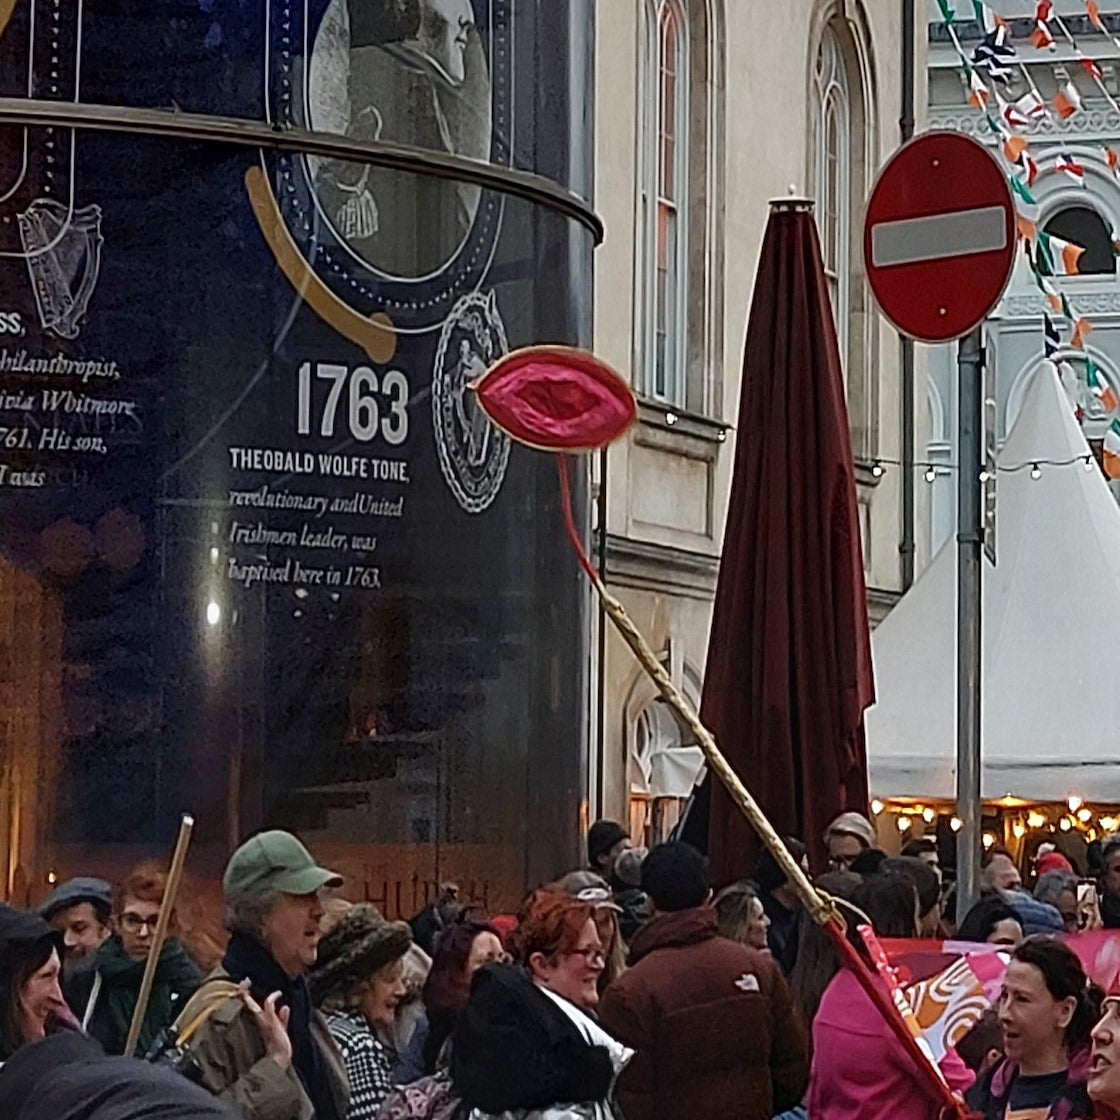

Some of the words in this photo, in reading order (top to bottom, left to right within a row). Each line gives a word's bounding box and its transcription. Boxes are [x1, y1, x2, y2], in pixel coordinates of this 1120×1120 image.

[298, 362, 408, 444] 1763
[38, 427, 72, 450] His
[72, 436, 107, 454] son,
[229, 447, 314, 473] THEOBALD
[318, 453, 368, 478] WOLFE
[371, 459, 410, 484] TONE,
[229, 485, 328, 518] revolutionary
[330, 492, 359, 513] and
[359, 494, 404, 516] United
[230, 521, 297, 546] Irishmen
[300, 523, 348, 552] leader,
[351, 536, 376, 551] was
[228, 557, 291, 588] baptised
[293, 560, 324, 583] here
[326, 565, 341, 585] in
